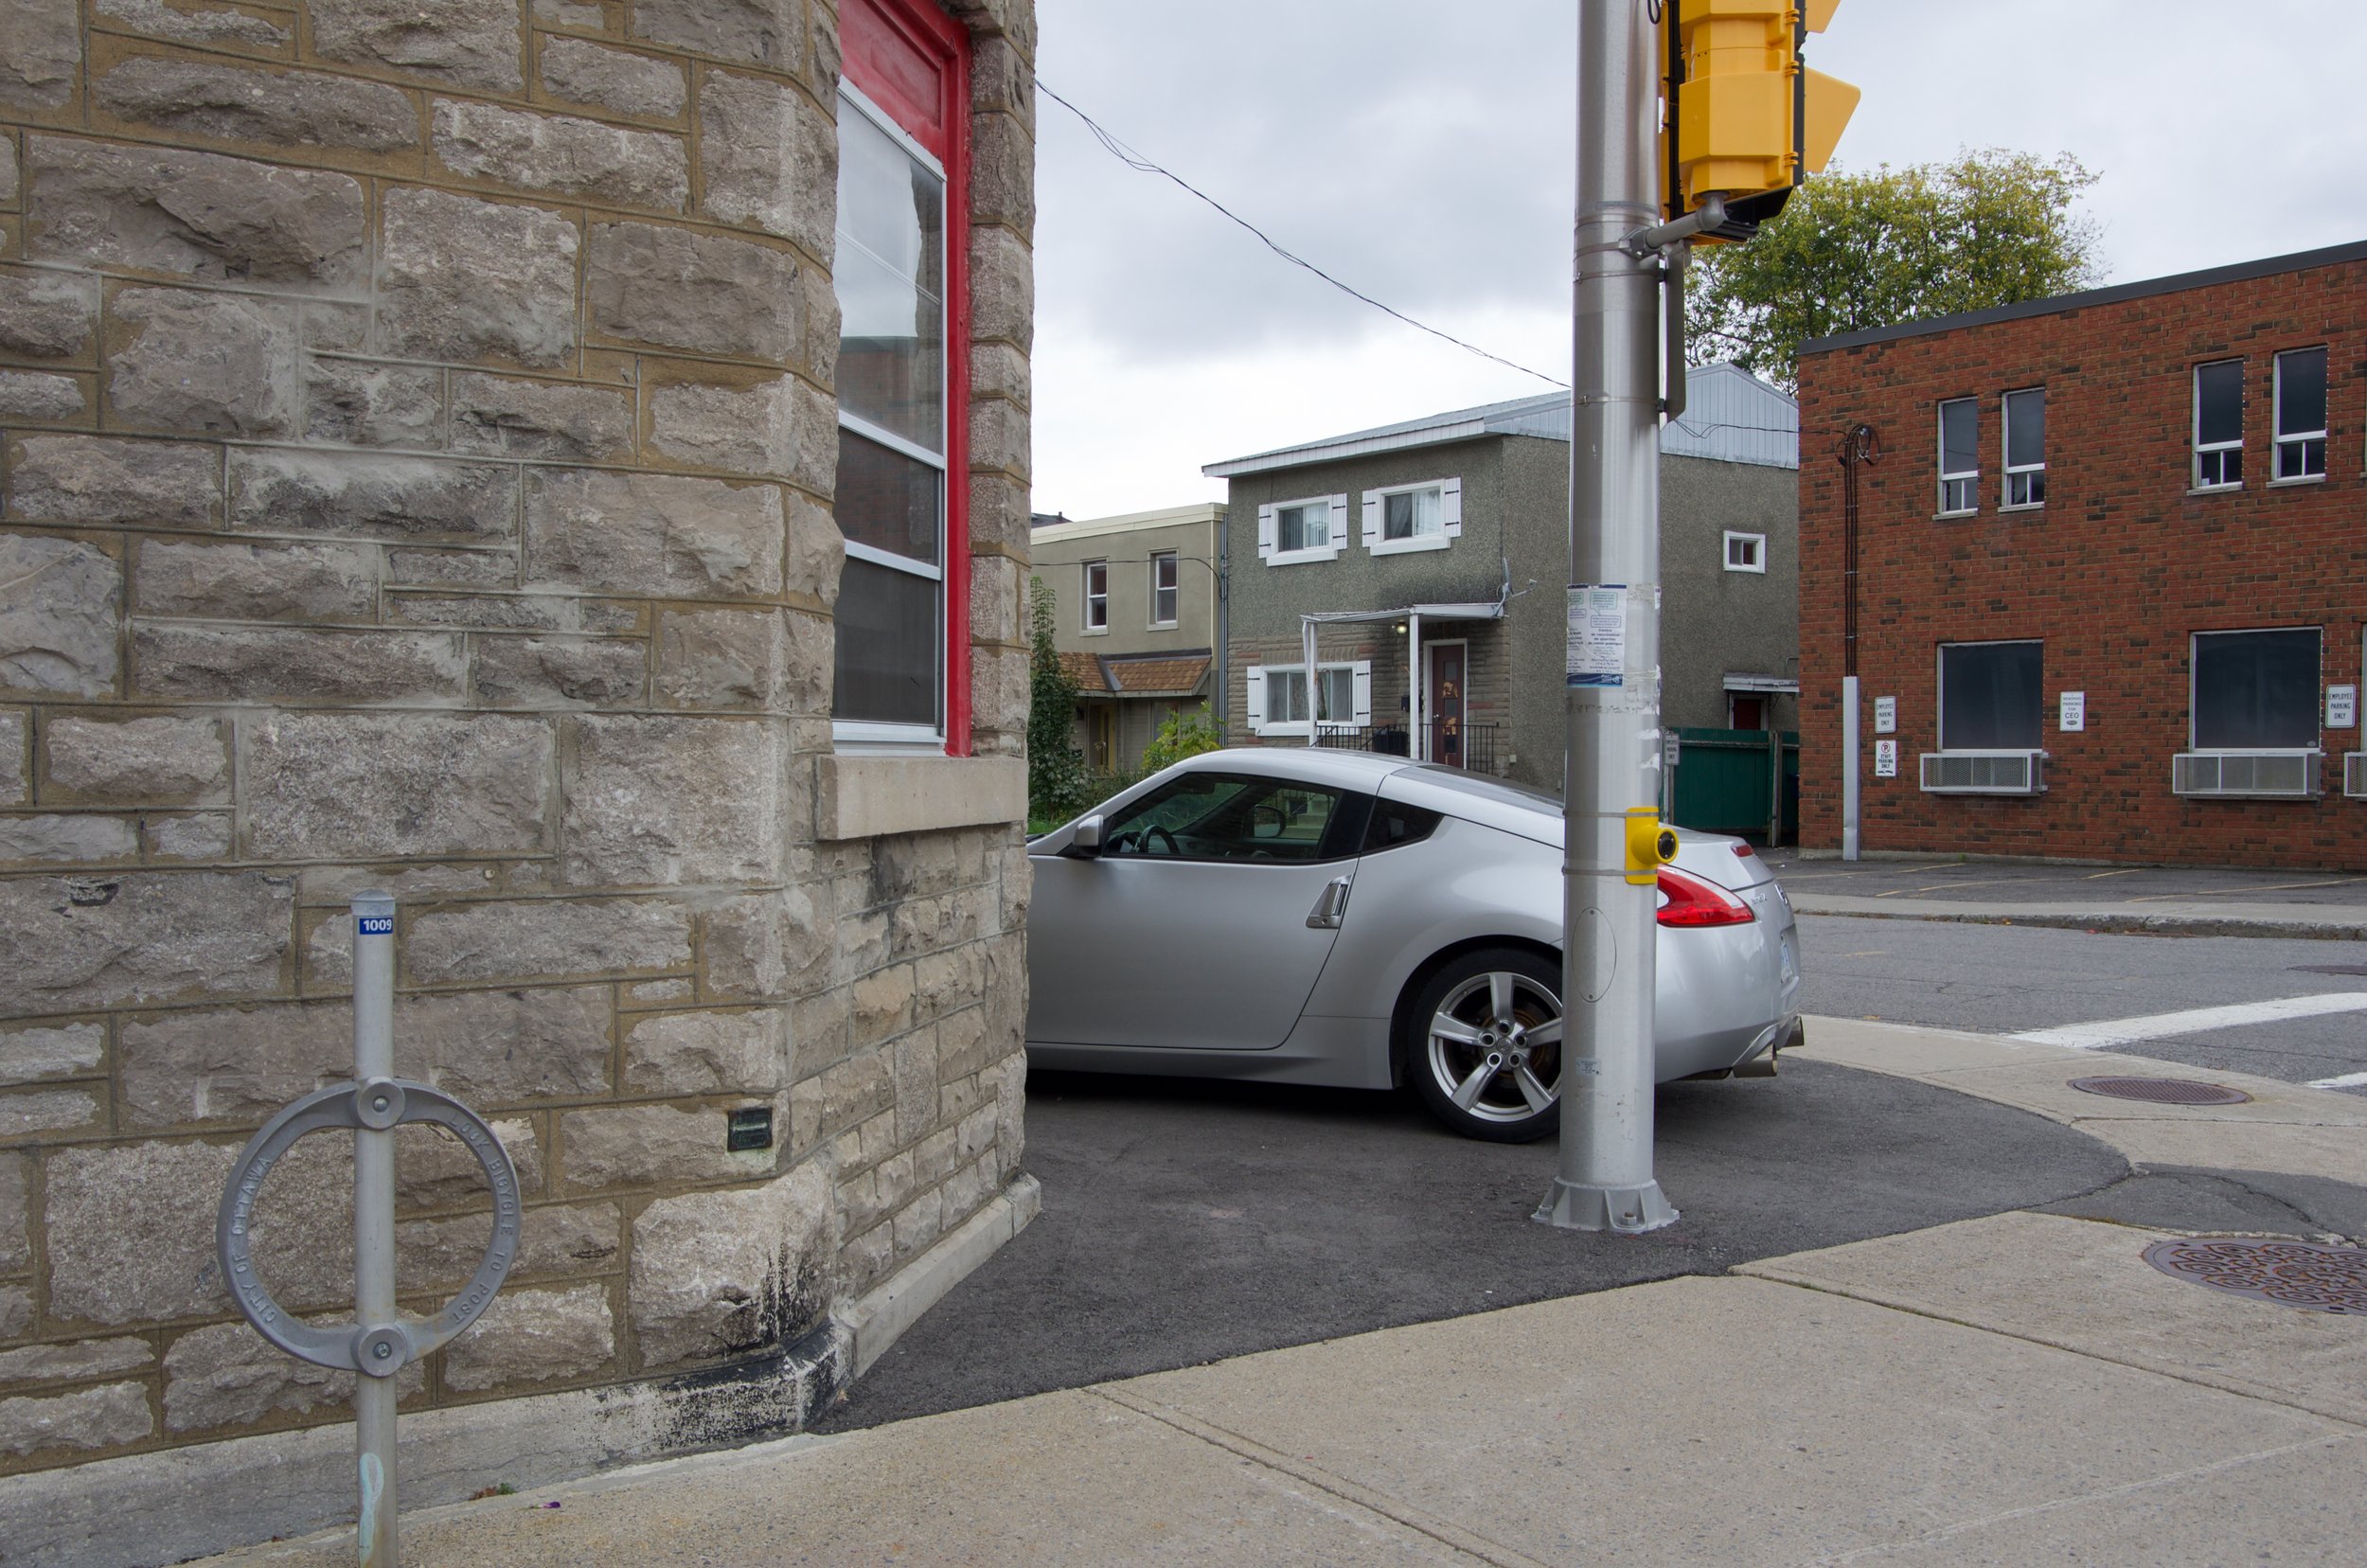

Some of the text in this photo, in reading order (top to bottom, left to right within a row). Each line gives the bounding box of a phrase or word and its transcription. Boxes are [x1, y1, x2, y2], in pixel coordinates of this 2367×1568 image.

[364, 918, 392, 931] 1009
[232, 1157, 276, 1324] CITY OF OTTAWA
[448, 1113, 514, 1325] LOCK BICYCLE TO POST
